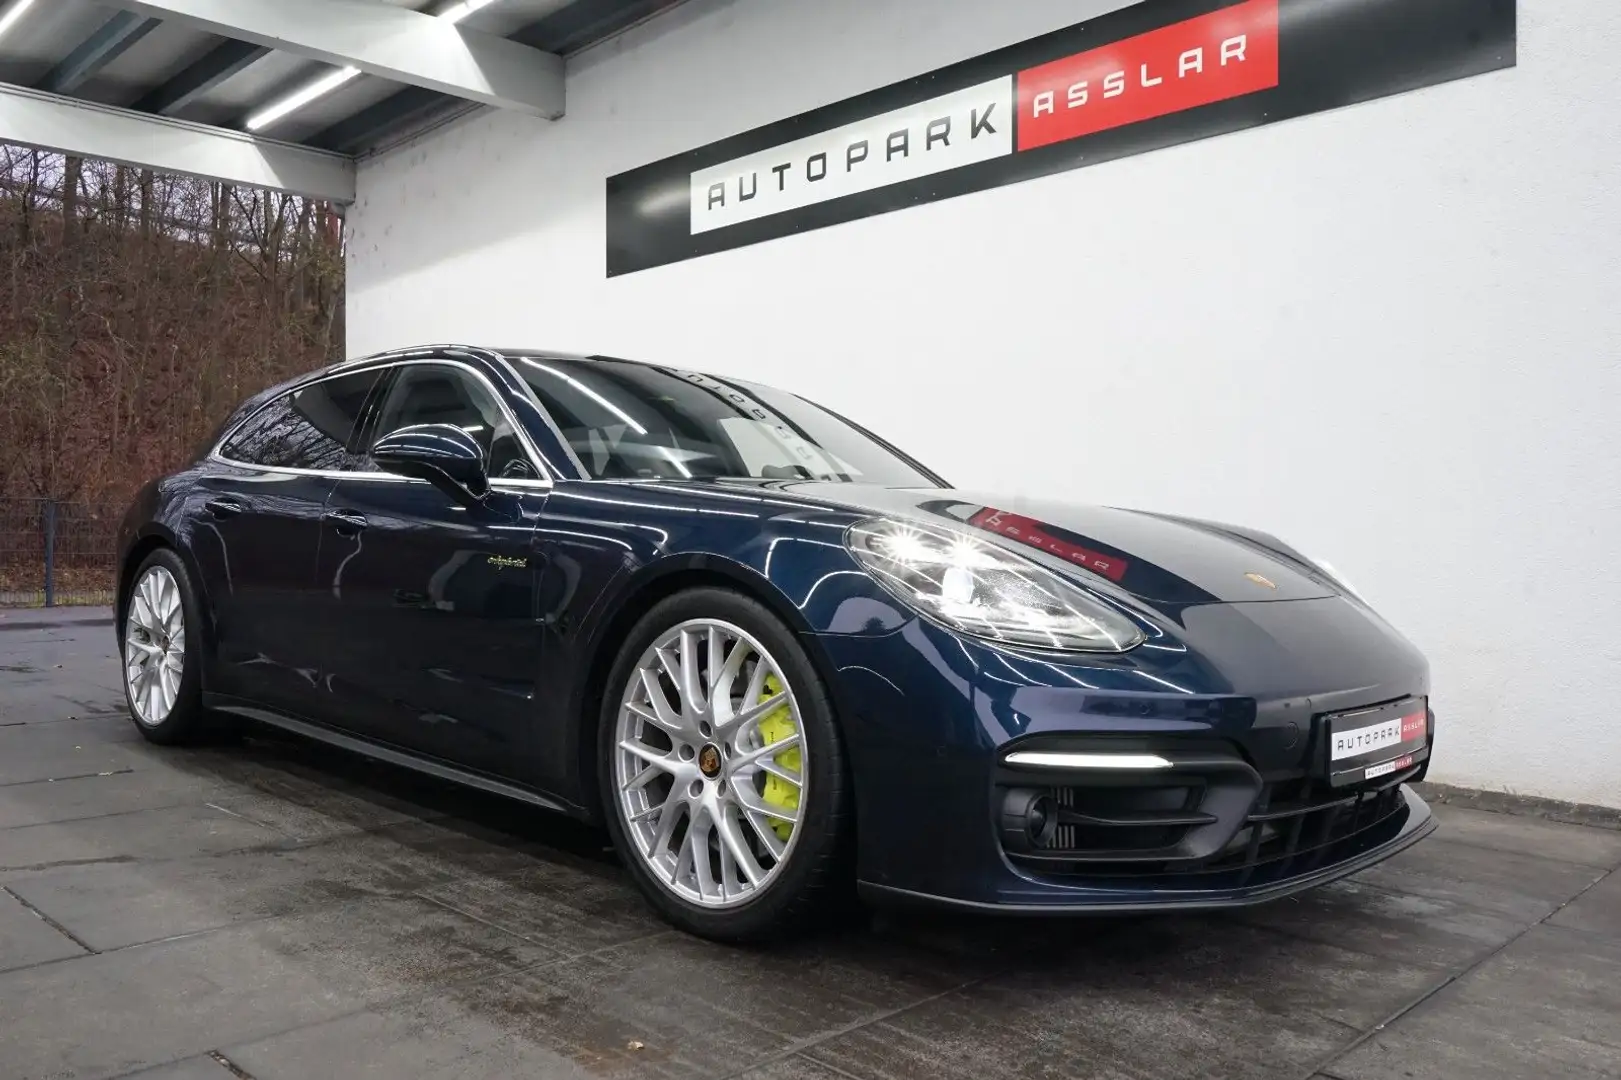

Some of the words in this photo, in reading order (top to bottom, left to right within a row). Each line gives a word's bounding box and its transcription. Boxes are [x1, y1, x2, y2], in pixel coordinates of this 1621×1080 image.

[706, 102, 997, 211] AUTOPARK
[1033, 33, 1247, 118] ASSLAR
[1337, 726, 1400, 751] AUTOPARK
